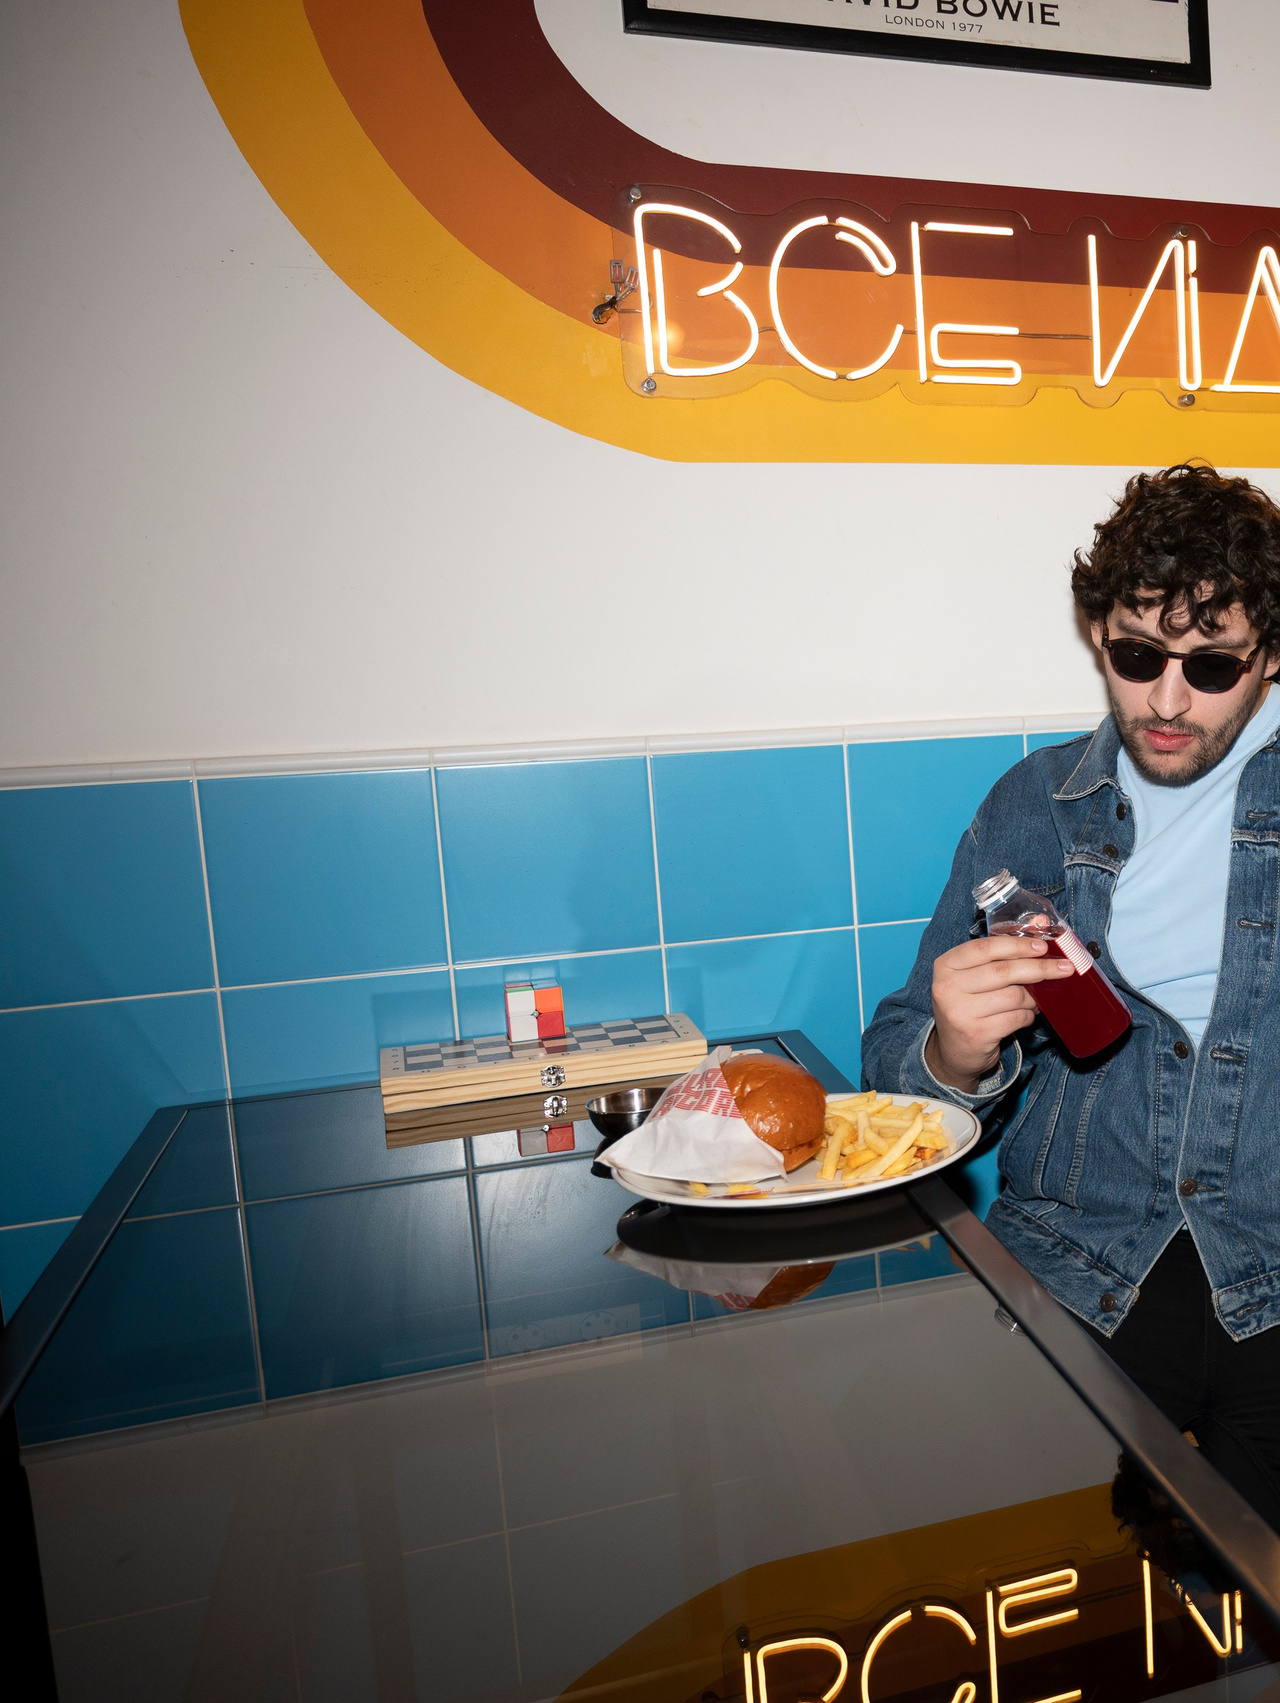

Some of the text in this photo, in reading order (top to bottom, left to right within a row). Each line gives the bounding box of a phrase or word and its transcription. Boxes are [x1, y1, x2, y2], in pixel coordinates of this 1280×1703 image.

[885, 14, 984, 34] LONDON 1977
[936, 0, 1061, 27] BOWIE
[634, 203, 1022, 385] ВСЕ
